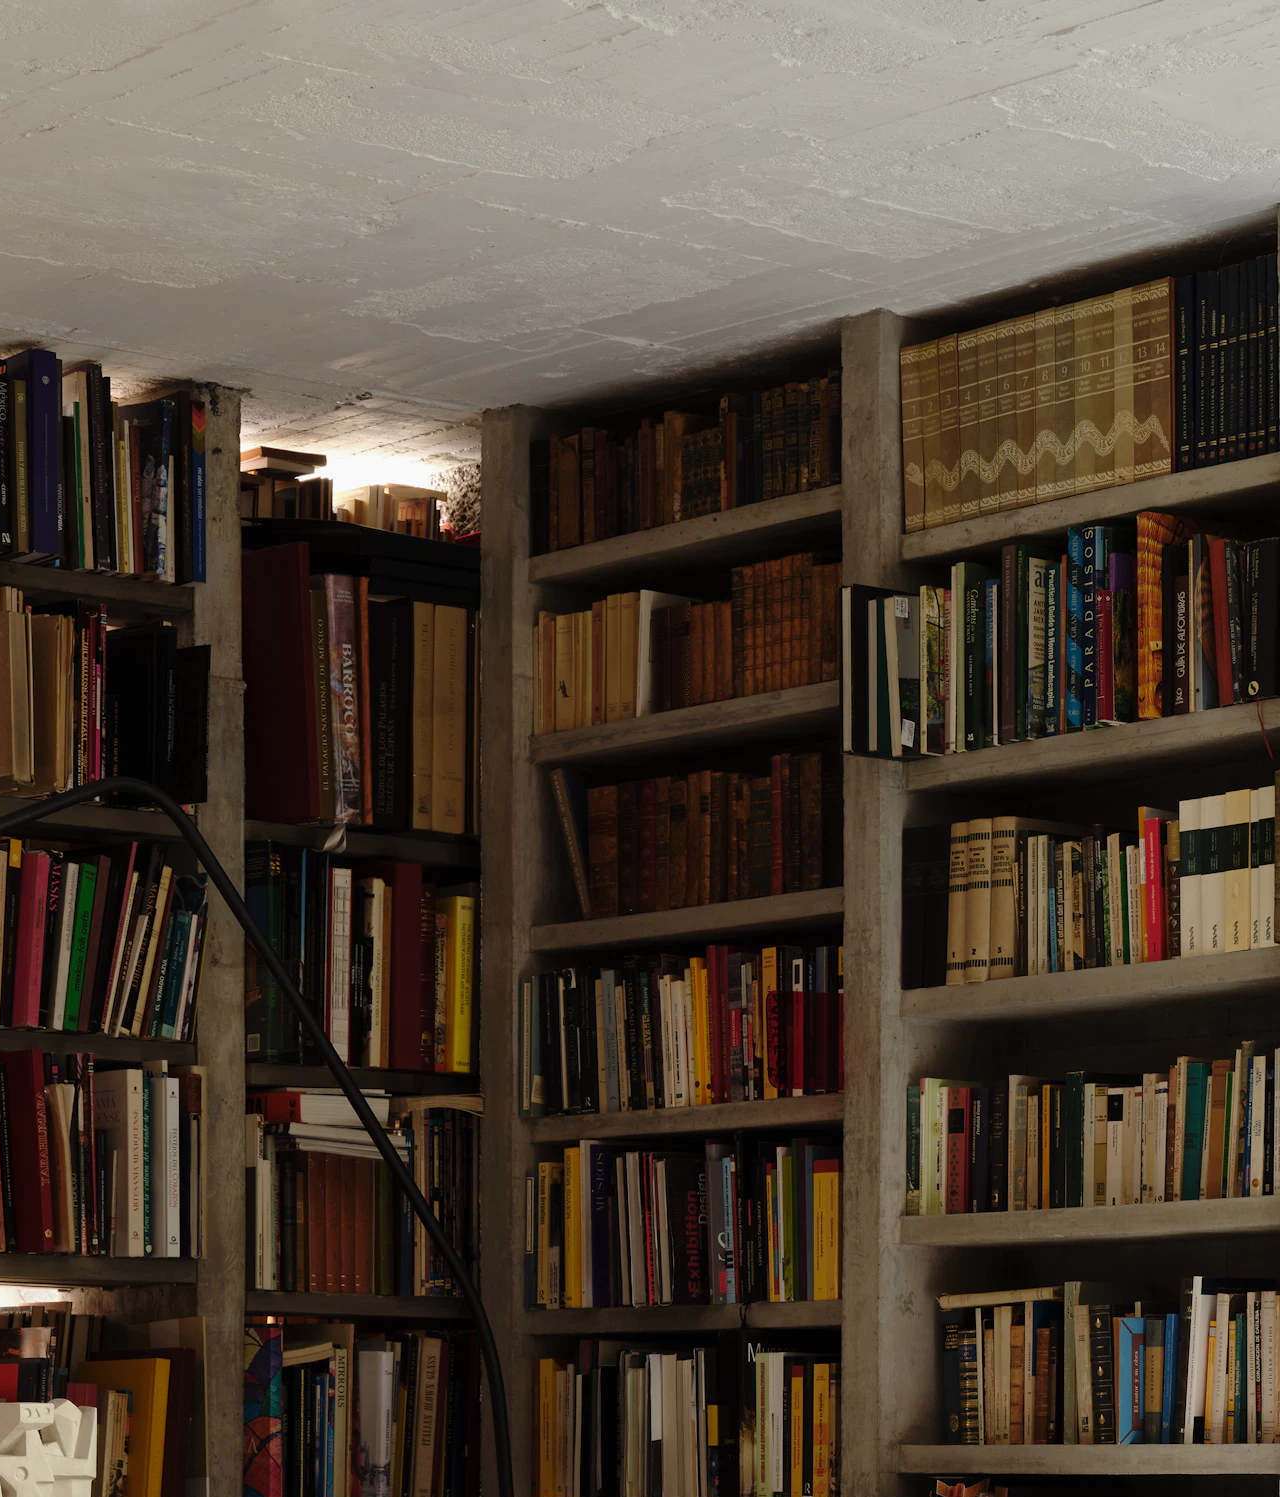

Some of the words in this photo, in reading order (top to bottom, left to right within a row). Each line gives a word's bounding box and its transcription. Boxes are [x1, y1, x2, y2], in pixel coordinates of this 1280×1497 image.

[1136, 346, 1146, 358] 13
[1154, 342, 1165, 354] 14
[984, 384, 990, 396] 5
[1002, 379, 1010, 392] 6
[1022, 376, 1028, 388] 7
[964, 390, 971, 402] 4
[1047, 570, 1056, 600] Practical
[969, 588, 979, 625] Gardens
[1046, 602, 1056, 624] Guide
[1084, 529, 1094, 688] PARADEISOS
[316, 618, 325, 658] MÉXICO
[1047, 625, 1055, 634] to
[1046, 635, 1056, 658] Home
[319, 662, 326, 675] DE
[342, 643, 356, 738] BARROCO
[1044, 660, 1056, 708] Landscaping
[320, 680, 328, 730] NACIONAL
[322, 780, 329, 790] EL
[50, 862, 62, 911] MASKS
[79, 910, 90, 934] crafts
[76, 936, 87, 952] folk
[996, 946, 1002, 954] 3
[73, 955, 84, 991] mexican
[36, 1092, 50, 1186] TARAHUMARA
[131, 1109, 140, 1163] MEXIQUENSE
[130, 1165, 140, 1212] ARTESANÍA
[684, 1190, 700, 1294] Exhibition
[696, 1172, 709, 1225] Design
[426, 1355, 436, 1380] GLASS
[424, 1384, 435, 1411] BLOWN
[422, 1414, 433, 1446] ITALIAN
